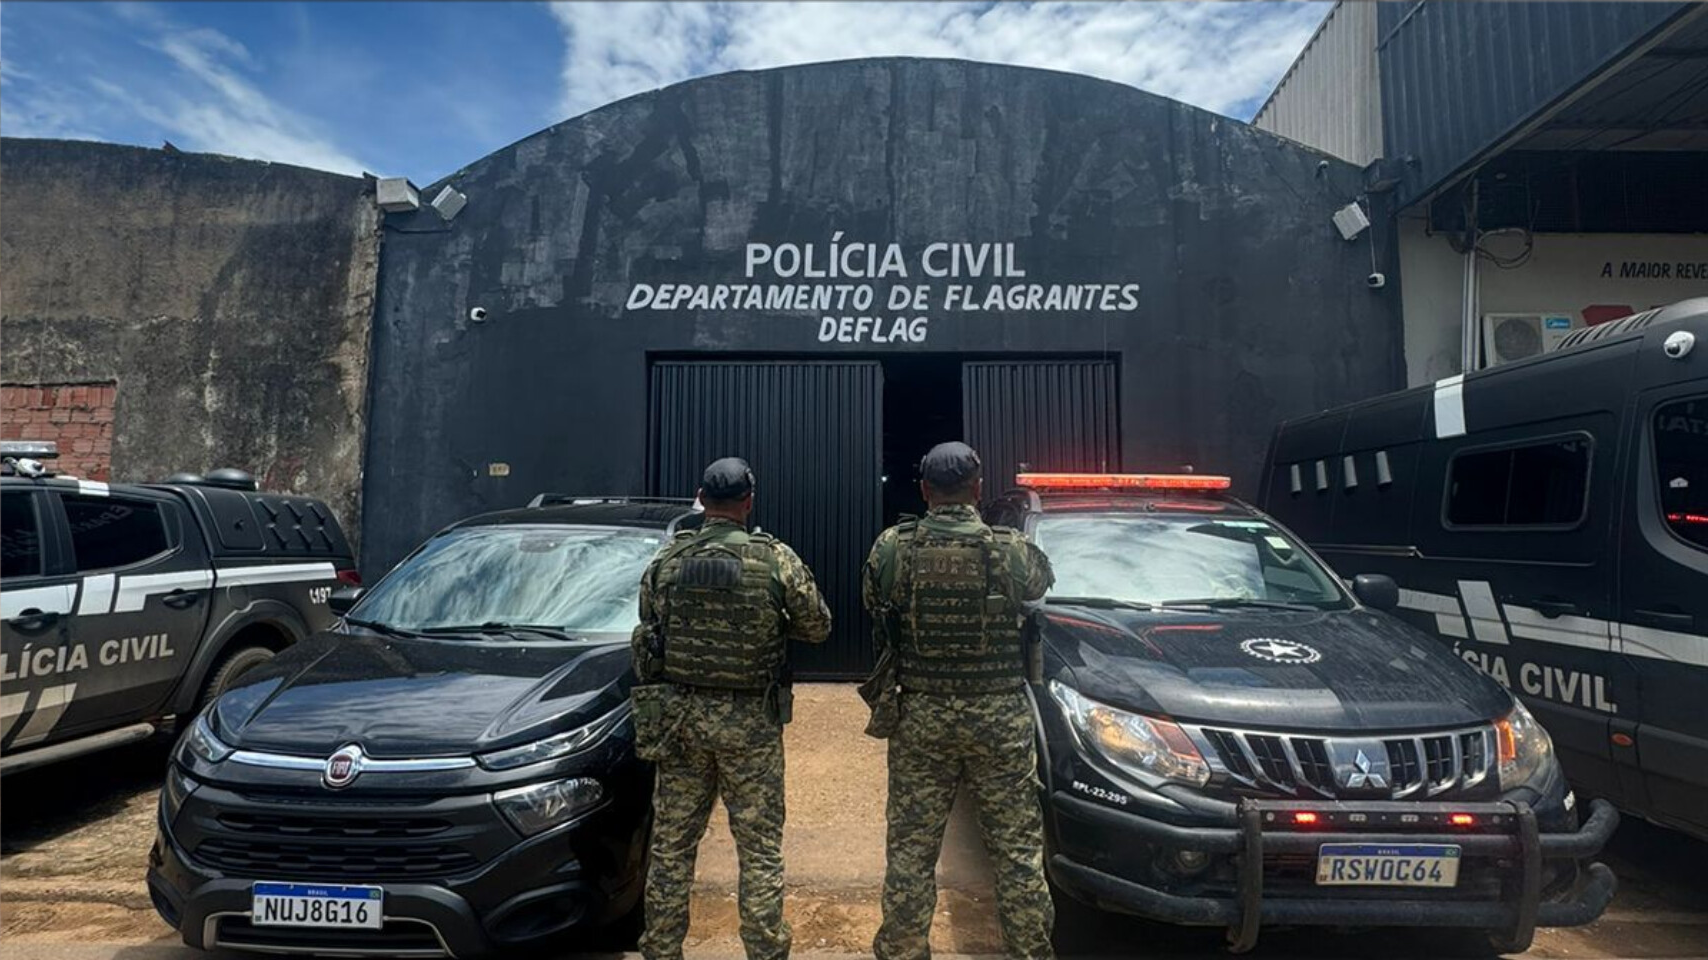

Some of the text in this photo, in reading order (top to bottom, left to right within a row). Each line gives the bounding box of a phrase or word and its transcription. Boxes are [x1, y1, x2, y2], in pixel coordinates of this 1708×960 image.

[745, 231, 1026, 278] POLÍCIA CIVIL
[1601, 262, 1612, 278] A
[1619, 262, 1671, 278] MAIOR
[626, 284, 1140, 310] DEPARTAMENTO DE FLAGRANTES
[818, 316, 928, 342] DEFLAG
[99, 633, 174, 666] CIVIL
[1520, 662, 1618, 713] CIVIL
[264, 897, 368, 924] NUJ8G16
